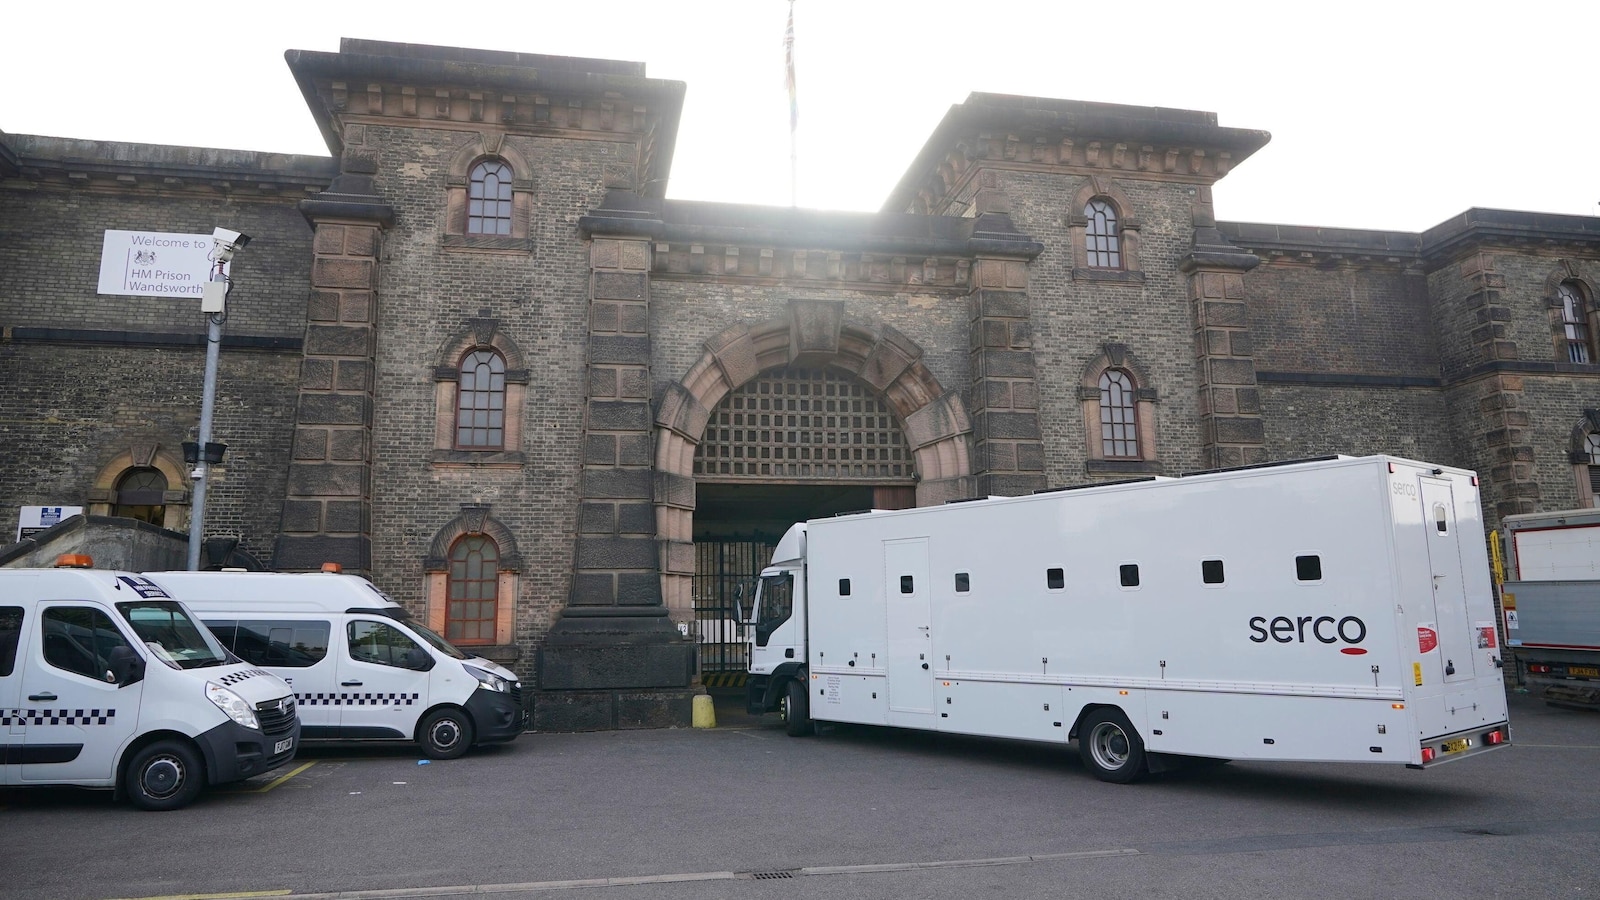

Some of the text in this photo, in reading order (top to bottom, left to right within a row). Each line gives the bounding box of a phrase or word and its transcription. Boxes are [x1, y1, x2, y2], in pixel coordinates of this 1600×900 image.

[131, 235, 206, 249] Welcome to
[131, 268, 191, 281] HM Prison
[129, 281, 203, 294] Wandsworth
[1393, 481, 1416, 497] serco
[1249, 616, 1367, 644] serco
